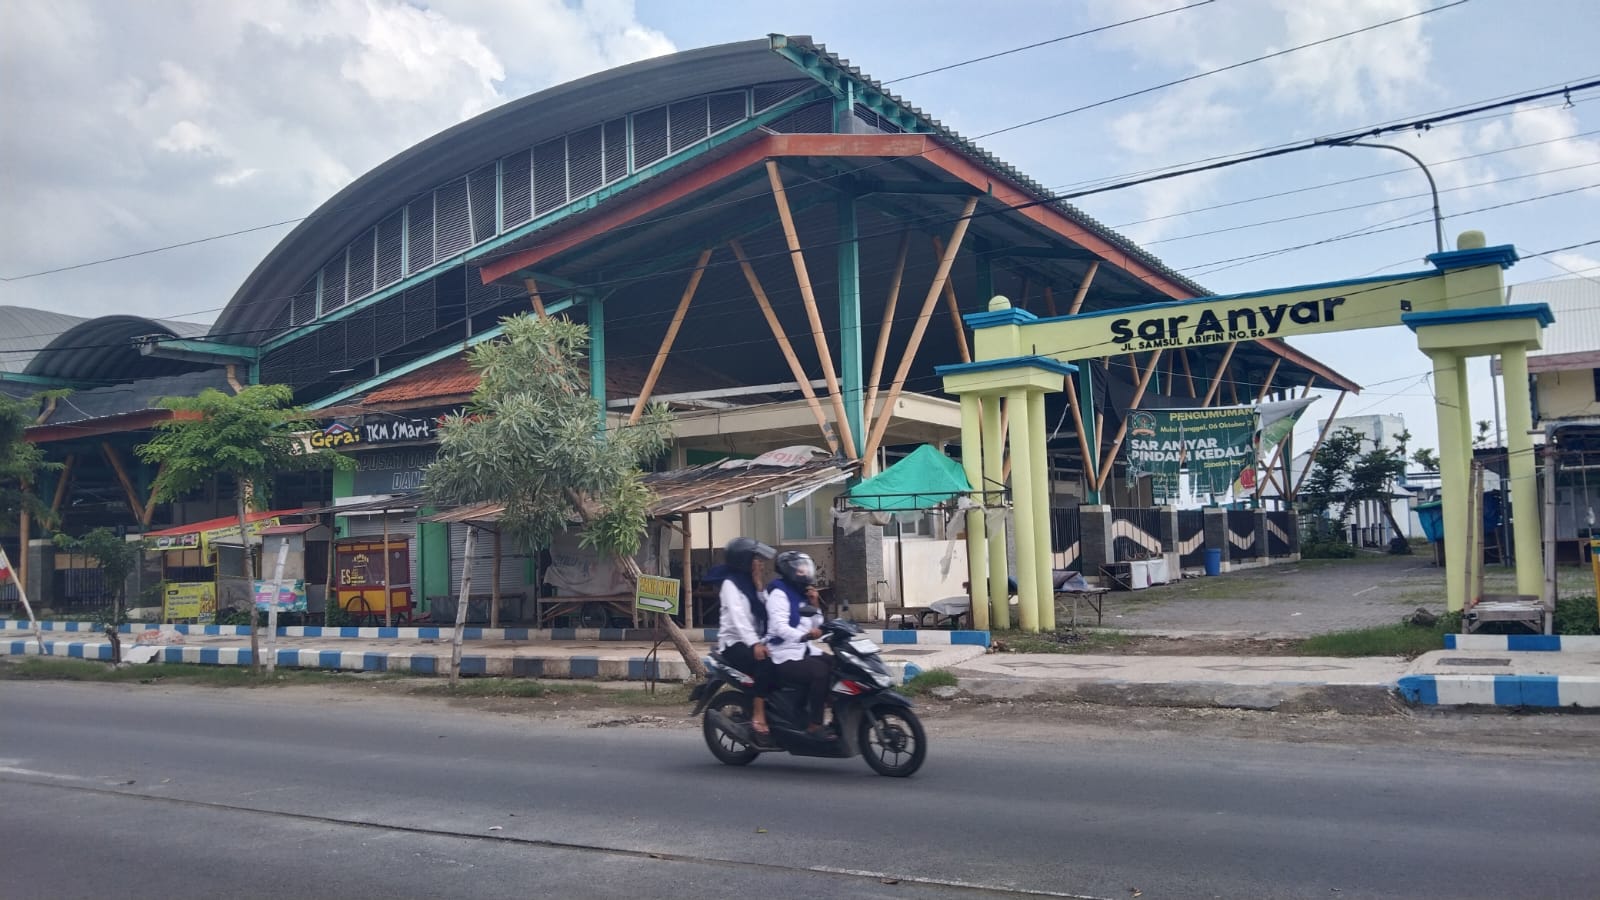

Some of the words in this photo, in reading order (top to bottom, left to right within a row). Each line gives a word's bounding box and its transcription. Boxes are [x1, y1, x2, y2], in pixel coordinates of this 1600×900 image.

[1110, 315, 1189, 344] Sar
[1194, 298, 1346, 334] Anyar
[1121, 343, 1137, 351] JL.
[1139, 338, 1183, 350] SAMSUL
[1187, 331, 1224, 345] ARIFIN
[1169, 408, 1254, 422] PENGUMUMAN
[311, 428, 361, 448] Gerai
[366, 424, 389, 442] IKM
[1179, 424, 1208, 434] anggal,
[1219, 420, 1246, 429] Oktober
[1131, 438, 1159, 450] SAR
[392, 470, 421, 490] DAN
[341, 569, 351, 585] ES
